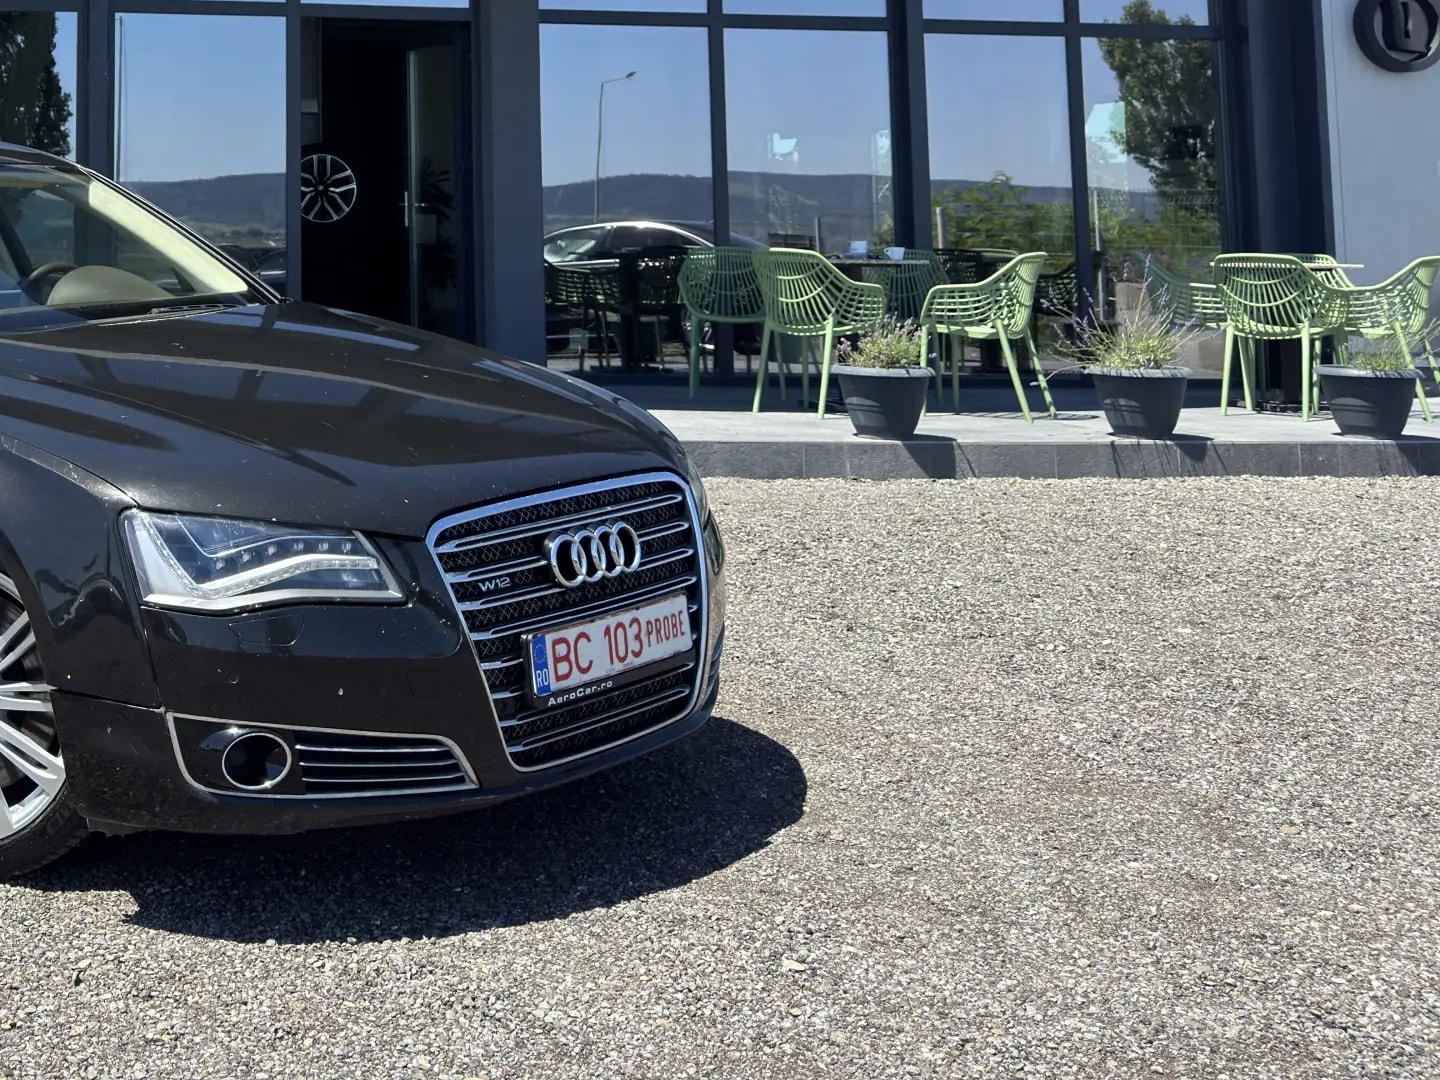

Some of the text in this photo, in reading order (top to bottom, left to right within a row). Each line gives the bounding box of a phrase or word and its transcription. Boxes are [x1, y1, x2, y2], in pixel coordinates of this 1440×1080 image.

[478, 577, 510, 592] W12
[551, 610, 686, 683] BC 103 PROBE
[535, 670, 549, 687] RO
[547, 680, 613, 707] AeroCar.ro
